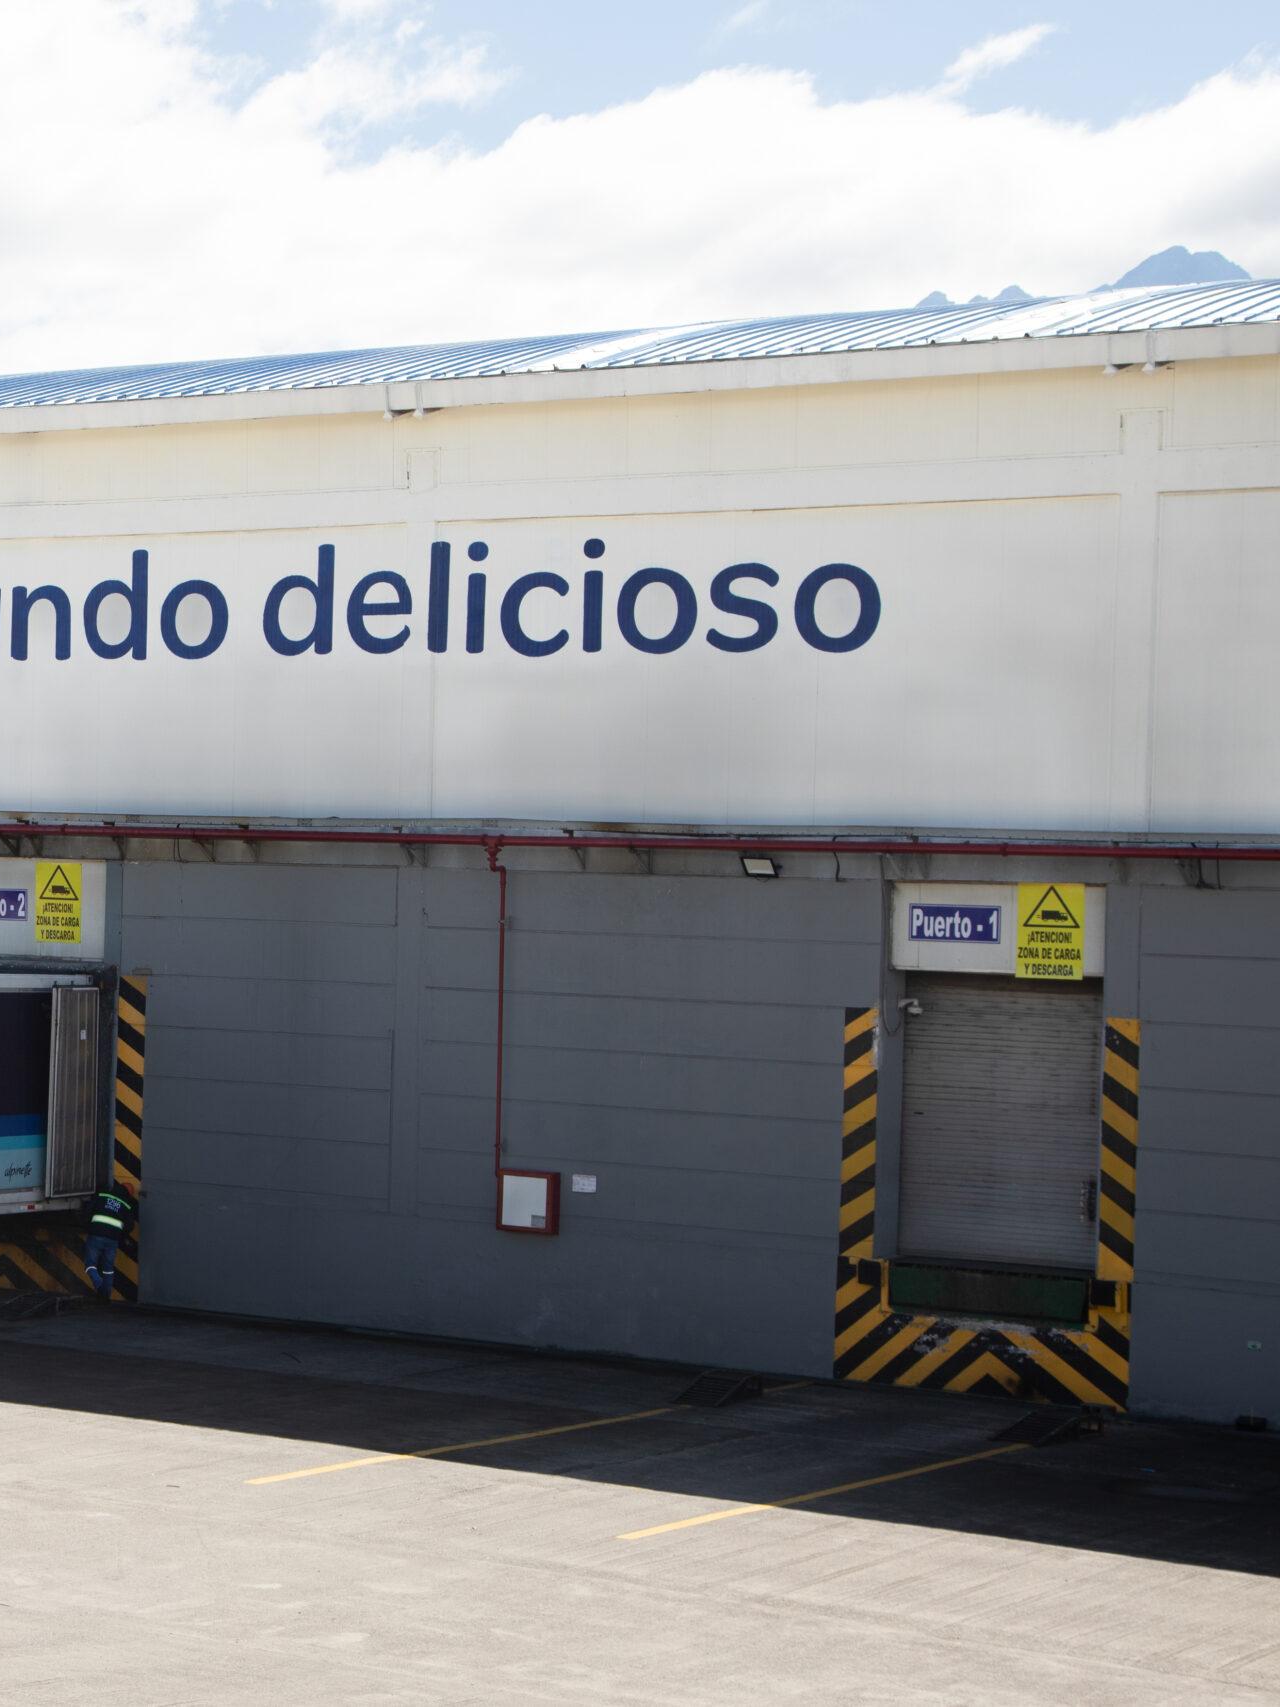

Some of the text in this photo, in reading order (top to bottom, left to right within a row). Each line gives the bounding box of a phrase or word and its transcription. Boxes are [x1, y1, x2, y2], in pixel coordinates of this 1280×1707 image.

[263, 538, 881, 657] delicioso
[17, 892, 26, 917] 2
[36, 915, 80, 927] ZONA DE CARGA
[911, 908, 972, 939] Puerto
[988, 910, 998, 940] 1
[45, 930, 75, 941] DESCARGA
[1017, 947, 1081, 961] ZONA DE CARGA
[1031, 963, 1074, 977] DESCARGA
